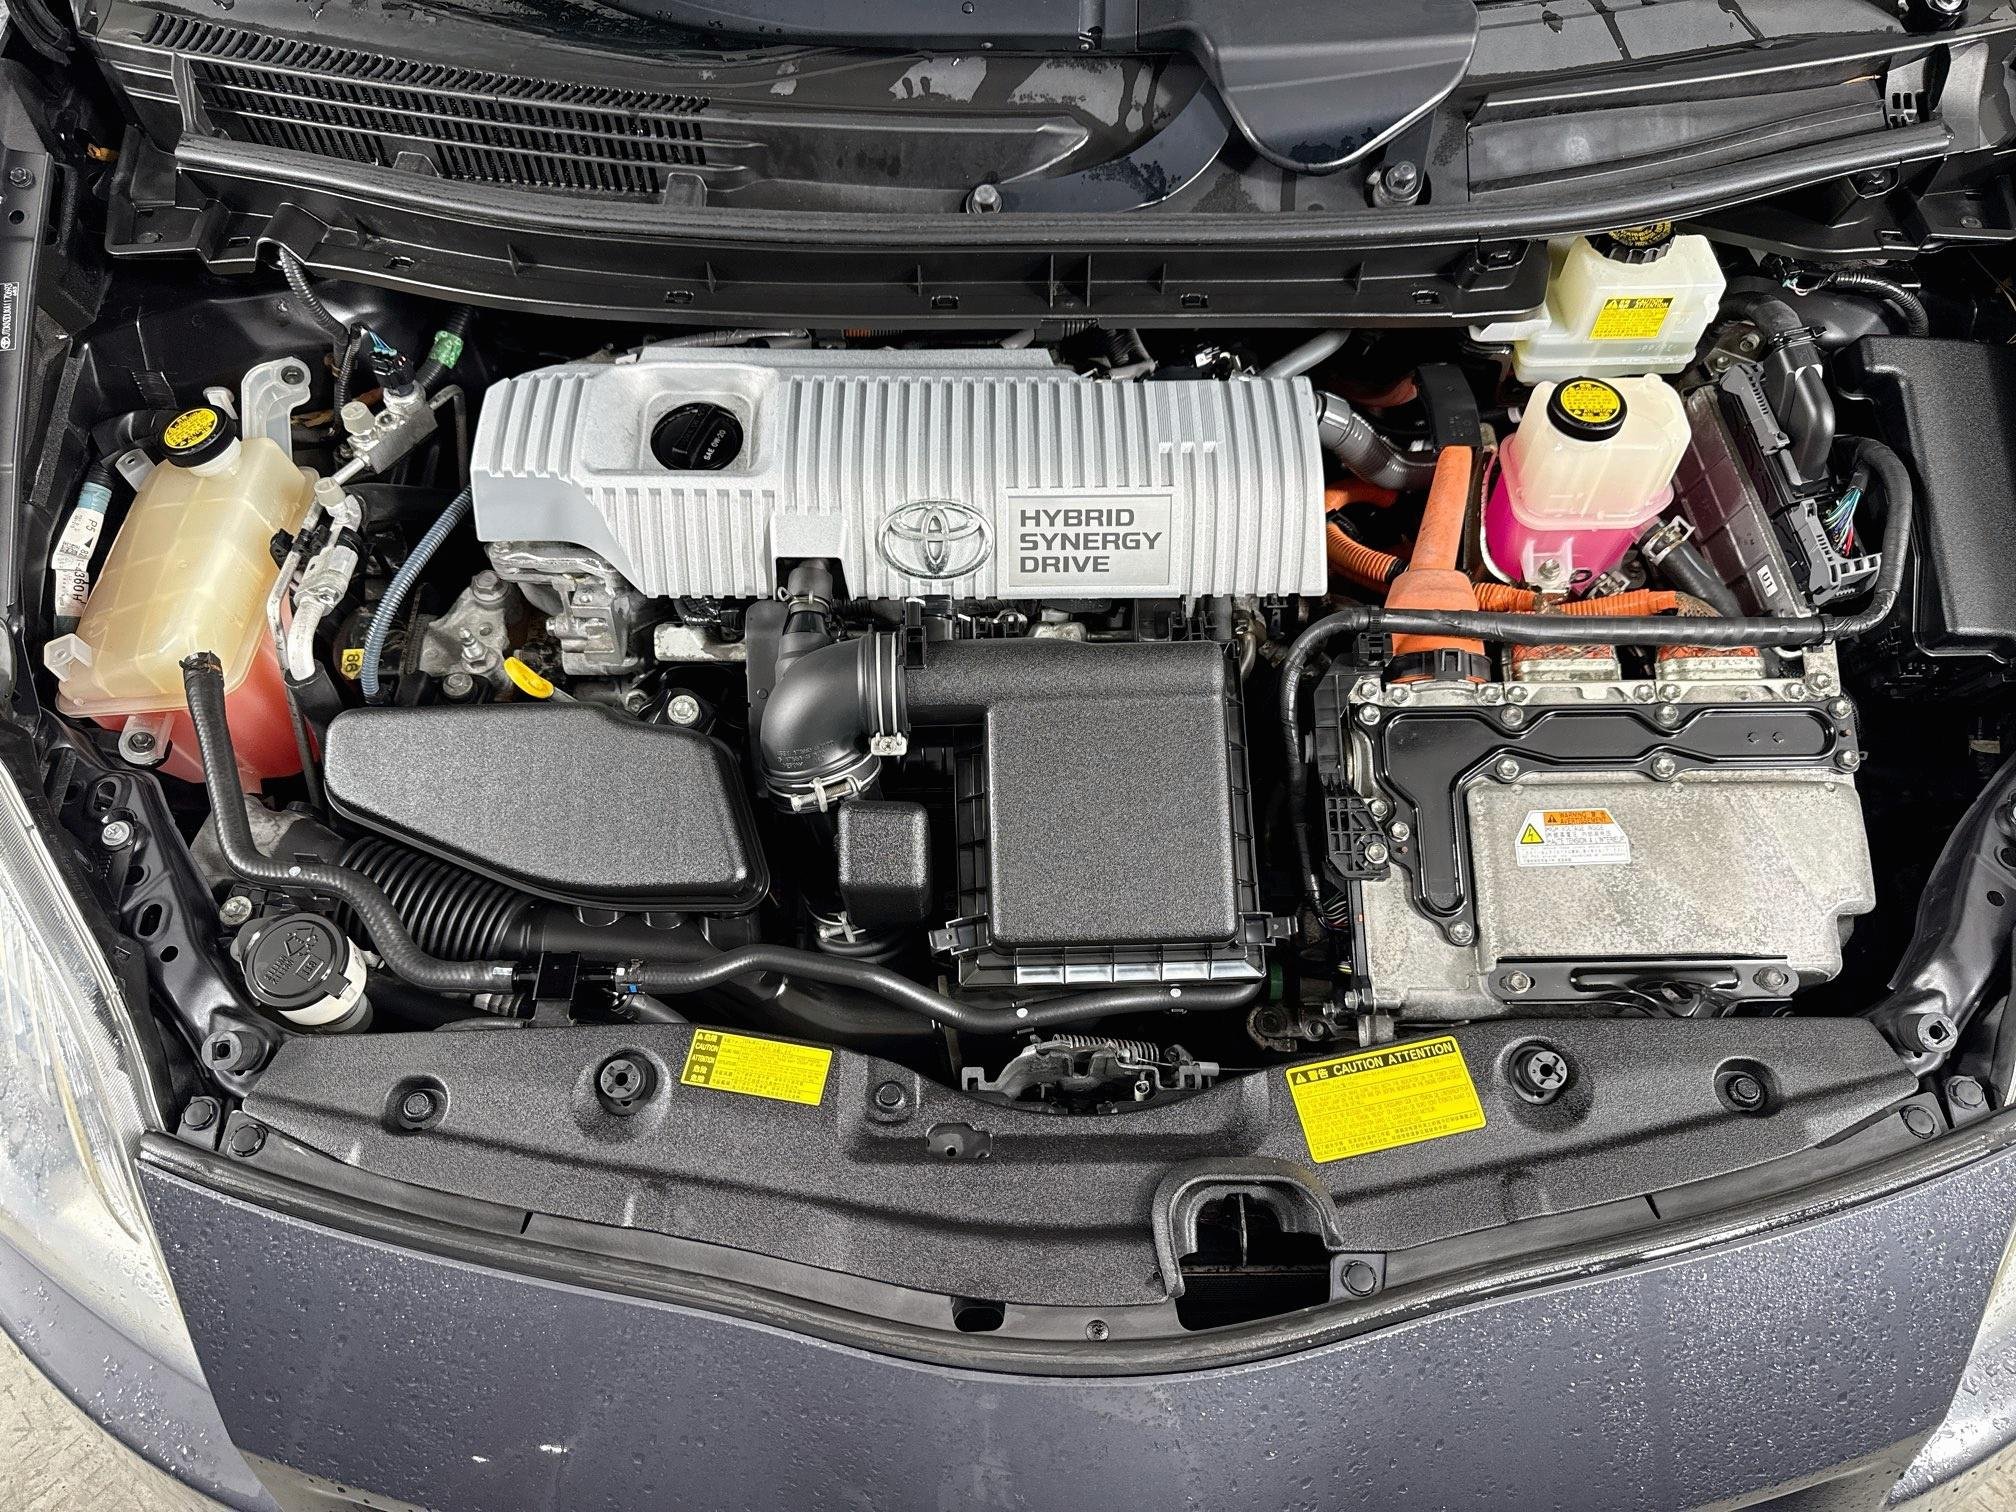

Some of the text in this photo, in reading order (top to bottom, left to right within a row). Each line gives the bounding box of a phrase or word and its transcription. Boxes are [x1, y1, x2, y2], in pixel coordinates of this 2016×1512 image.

[703, 429, 726, 461] SAE 0W-20
[1020, 509, 1135, 527] HYBRID
[1020, 531, 1162, 551] SYNERGY
[1020, 556, 1110, 573] DRIVE
[695, 1042, 719, 1053] CAUTION
[691, 1054, 716, 1064] ATTENTION
[1333, 1056, 1384, 1077] CAUTION
[1388, 1042, 1453, 1065] ATTENTION
